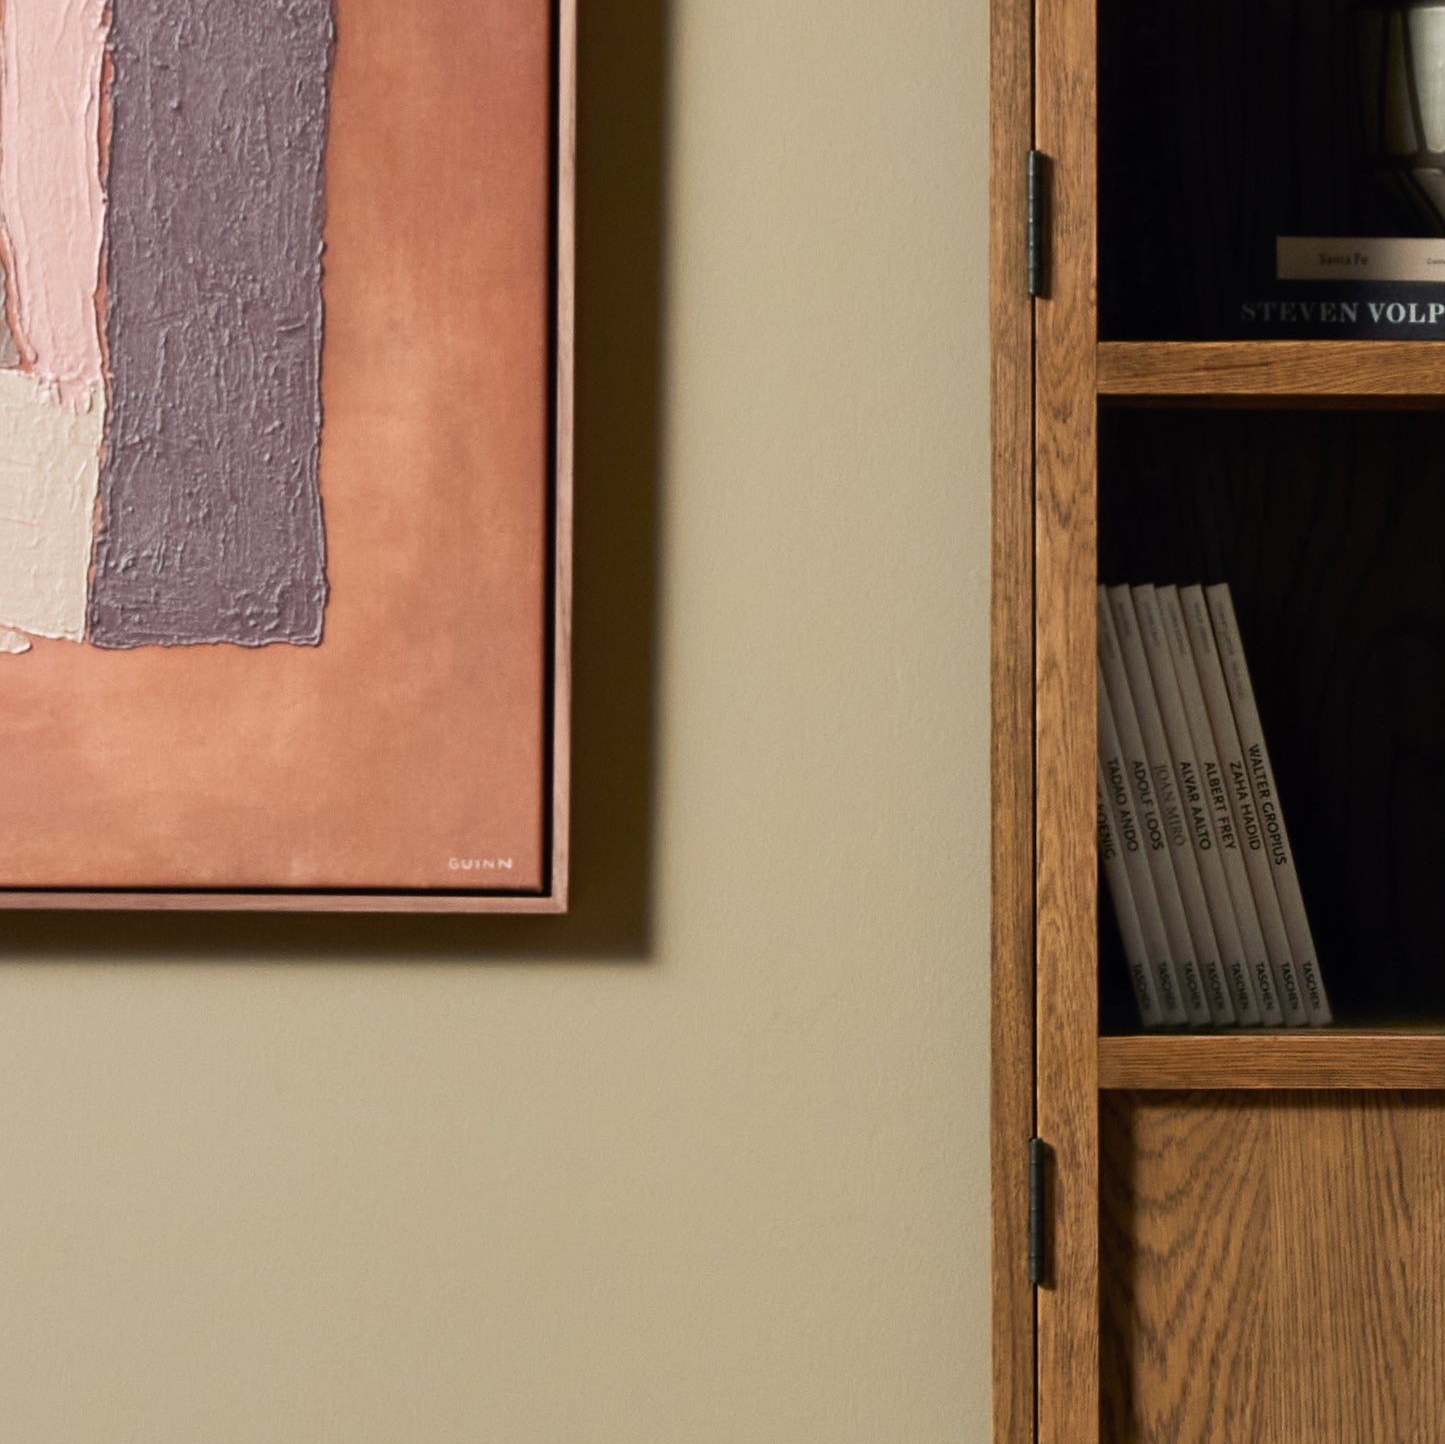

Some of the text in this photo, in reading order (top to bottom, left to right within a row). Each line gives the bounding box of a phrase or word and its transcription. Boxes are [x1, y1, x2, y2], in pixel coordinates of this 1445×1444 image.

[1240, 301, 1359, 324] STEVEN
[1108, 757, 1138, 852] TADAO ANDO
[1132, 761, 1164, 851] ADOLF LOOS
[1153, 765, 1174, 801] JOAN
[1181, 762, 1211, 850] ALVAR AALTO
[1204, 762, 1236, 850] ALBERT FREY
[1230, 761, 1261, 850] ZAHA HADID
[1248, 744, 1287, 865] WALTER GROPIUS
[1184, 961, 1200, 1010] TASCHEN
[1207, 962, 1224, 1010] TASCHEN
[1232, 963, 1249, 1010] TASCHEN
[1256, 962, 1274, 1010] TASCHEN
[1281, 962, 1298, 1010] TASCHEN
[1302, 962, 1320, 1008] TASCHEN
